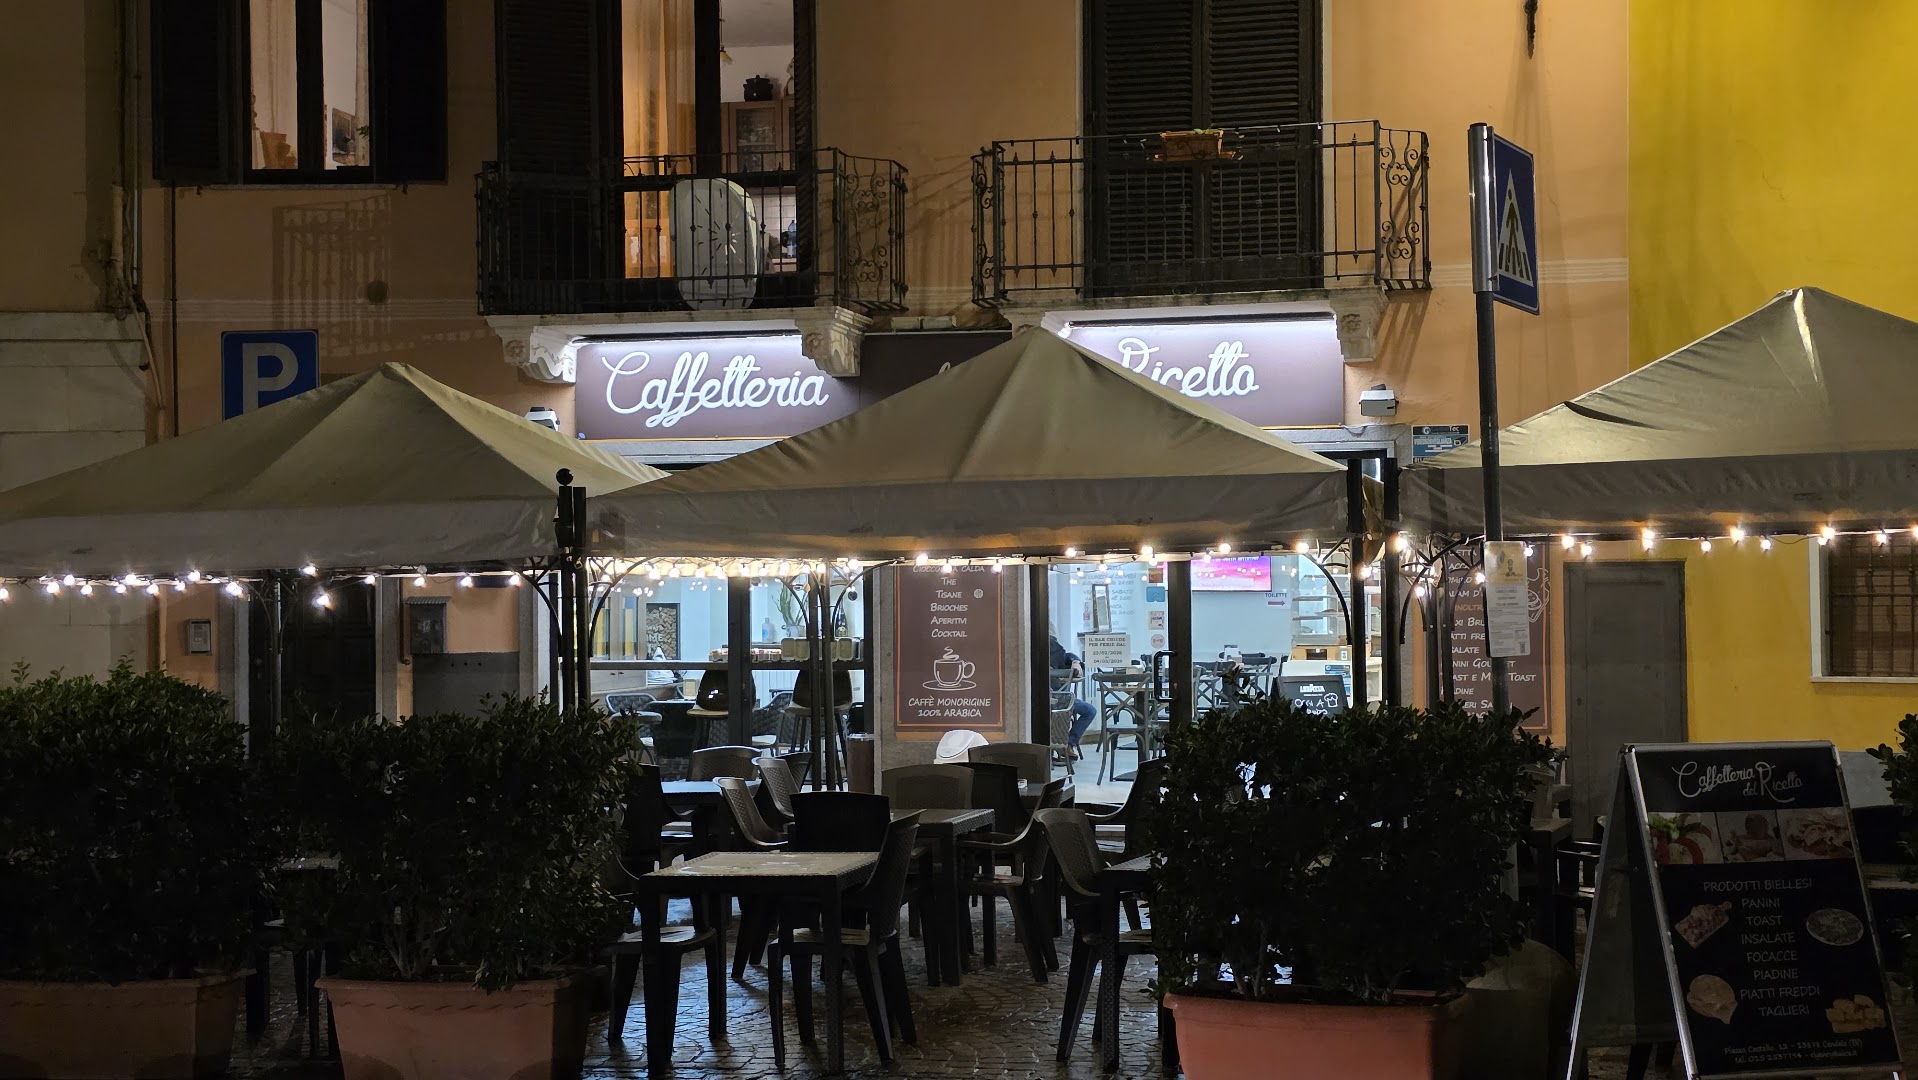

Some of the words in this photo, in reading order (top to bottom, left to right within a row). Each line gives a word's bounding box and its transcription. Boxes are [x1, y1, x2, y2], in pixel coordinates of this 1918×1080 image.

[242, 343, 299, 415] P
[601, 351, 829, 428] Caffetteria
[961, 565, 986, 573] CALDA
[941, 577, 958, 586] THE
[935, 590, 963, 599] TISANE
[930, 603, 969, 612] BRIOCHES
[1454, 604, 1484, 612] INOLTR
[930, 616, 968, 625] APERITIVI
[931, 629, 968, 638] COCKTAIL
[1470, 633, 1487, 641] FRE
[1452, 660, 1470, 668] NINI
[1452, 674, 1469, 682] AST
[1507, 672, 1538, 682] TOAST
[908, 695, 935, 707] CAFFÈ
[937, 697, 992, 707] MONORIGINE
[917, 709, 942, 717] 100%
[943, 708, 982, 718] ARABICA
[1671, 760, 1756, 798] Caffetteria
[1742, 782, 1758, 797] del
[1754, 761, 1803, 804] Ricetto
[1703, 880, 1761, 892] PRODOTTI
[1763, 878, 1813, 891] BIELLESI
[1741, 897, 1781, 909] PANINI
[1744, 915, 1784, 927] TOAST
[1740, 931, 1797, 945] INSALATE
[1746, 950, 1799, 963] FOCACCE
[1753, 968, 1800, 981] PIADINE
[1739, 987, 1776, 1000] PIATTI
[1778, 985, 1821, 998] FREDDI
[1758, 1004, 1811, 1017] TAGLIERI
